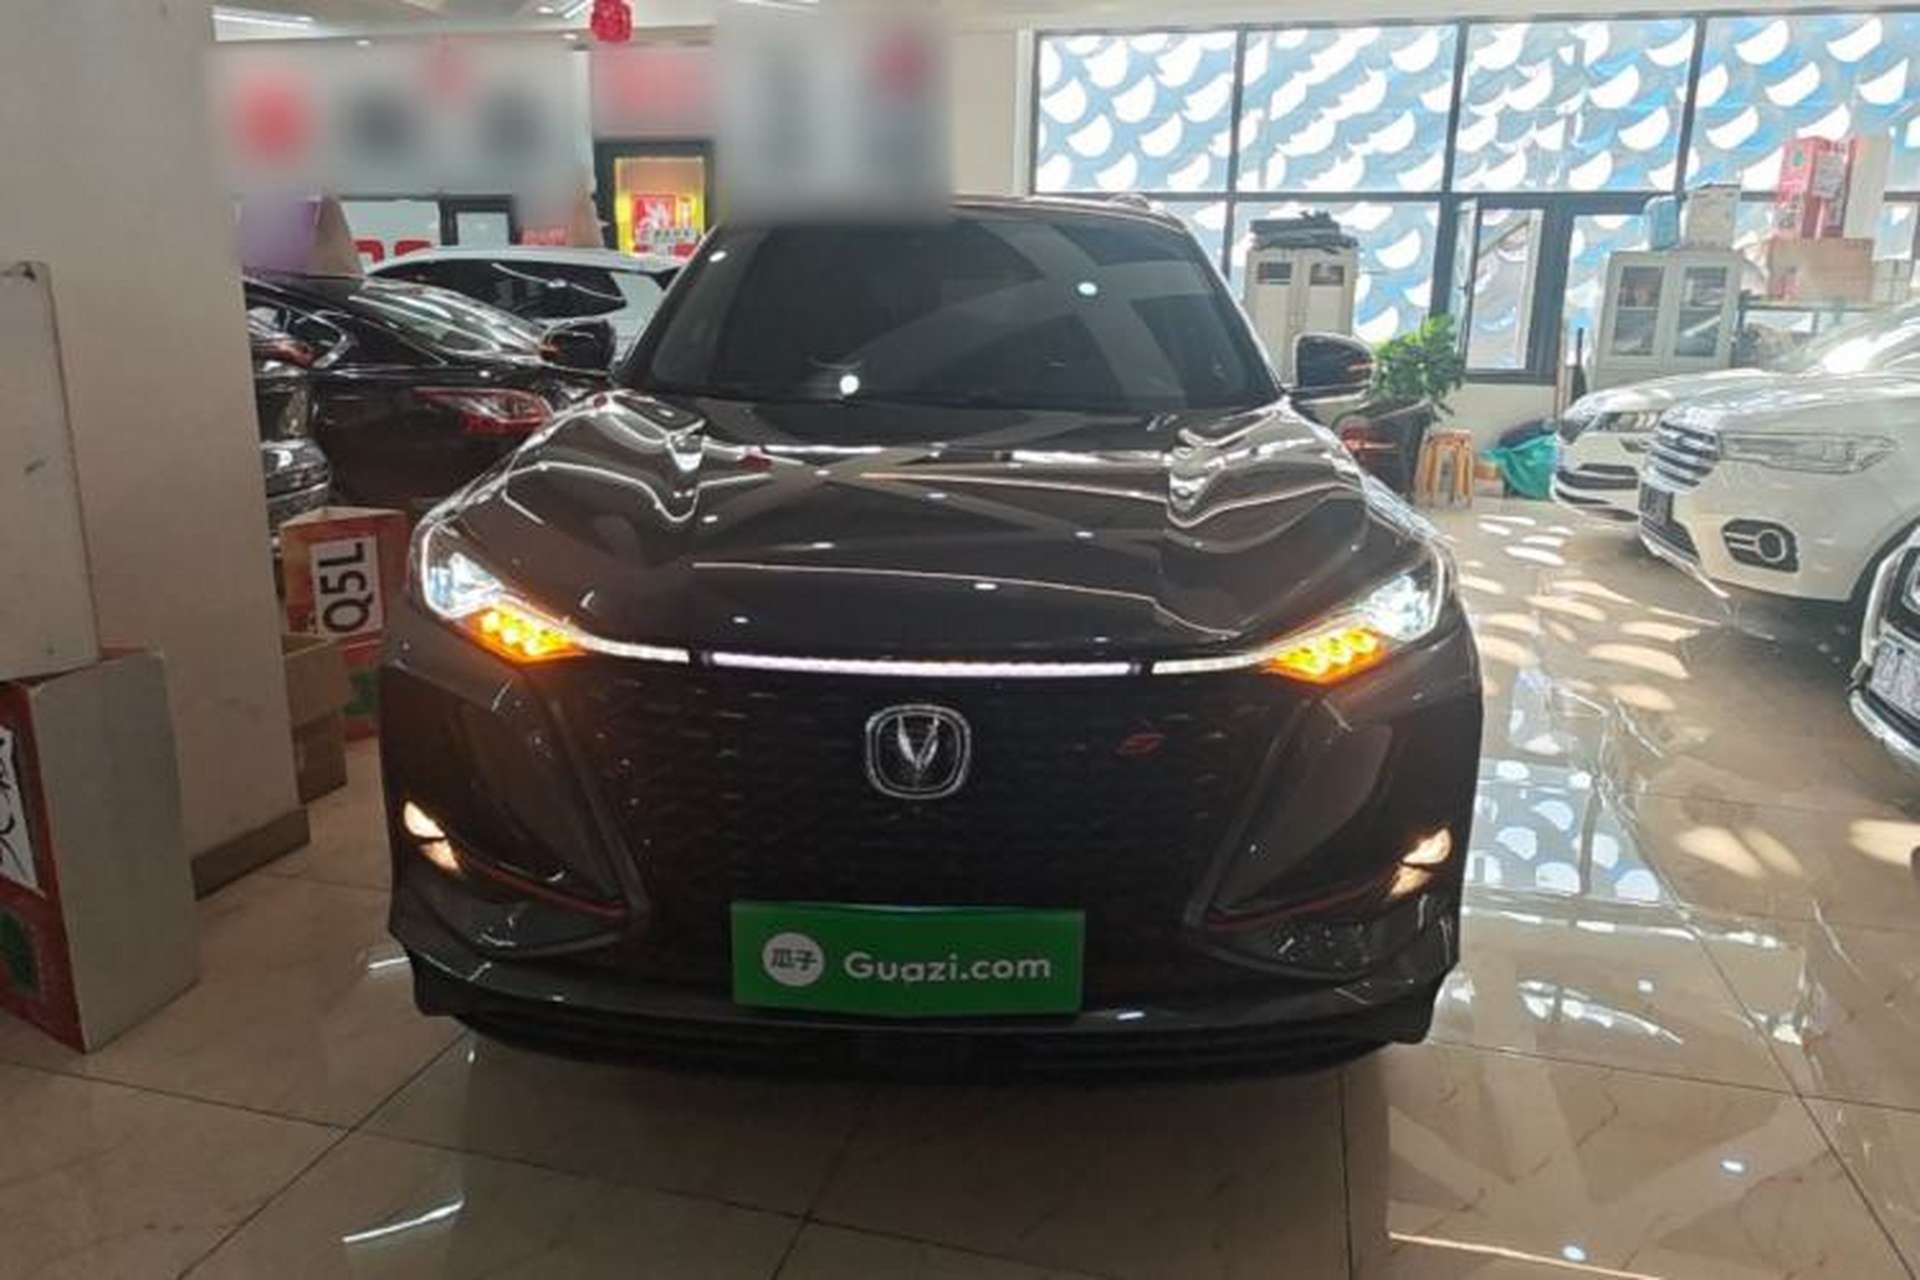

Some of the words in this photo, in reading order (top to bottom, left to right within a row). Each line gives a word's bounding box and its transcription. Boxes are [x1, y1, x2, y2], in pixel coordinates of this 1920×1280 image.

[318, 541, 374, 634] Q5L
[770, 947, 818, 971] 瓜子
[843, 951, 1052, 983] Guazi.com
